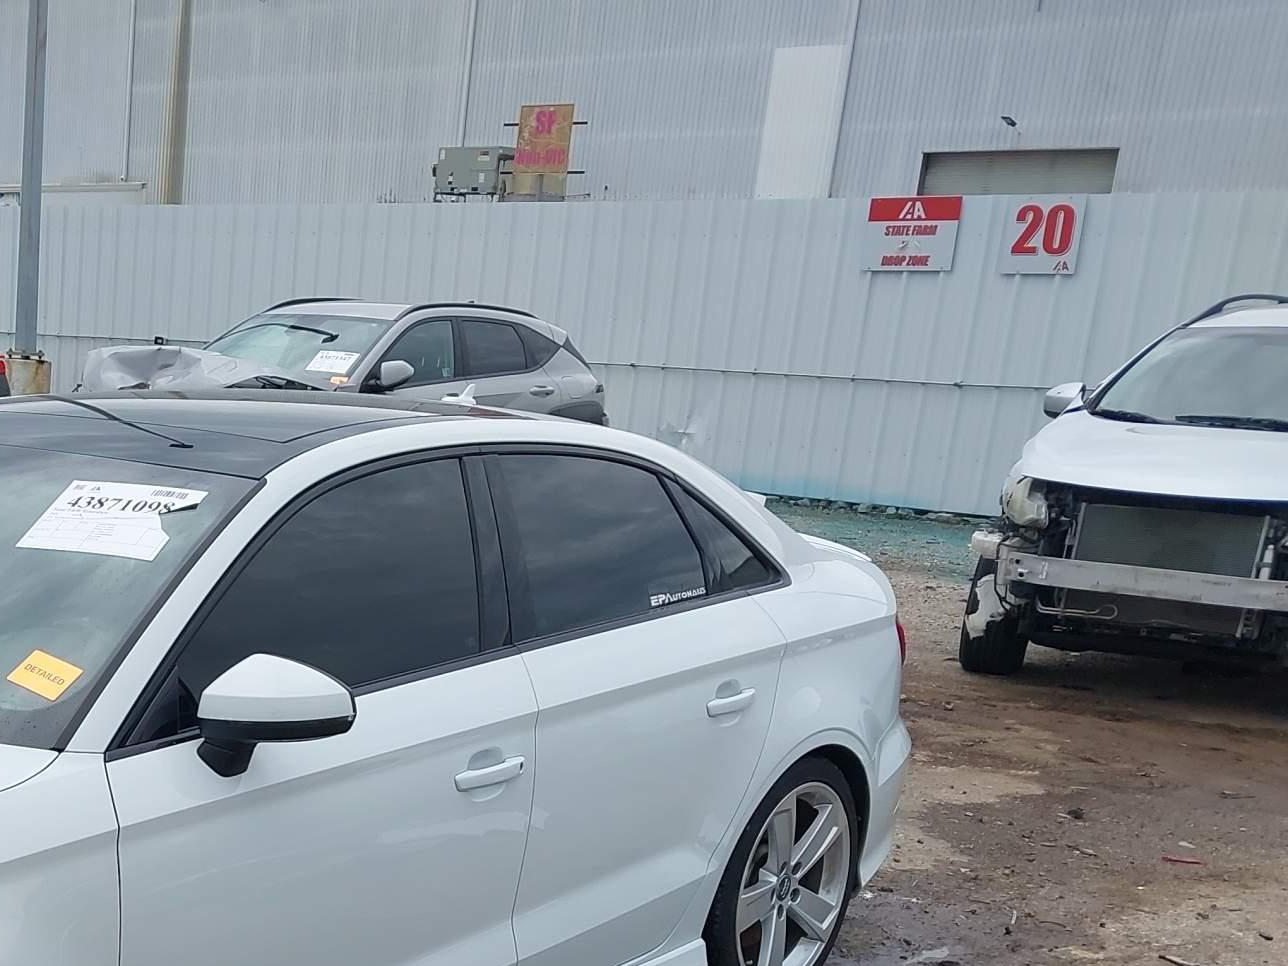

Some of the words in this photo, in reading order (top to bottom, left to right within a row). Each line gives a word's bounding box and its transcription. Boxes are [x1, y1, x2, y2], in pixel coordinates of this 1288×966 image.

[884, 225, 911, 236] STATE
[911, 225, 938, 236] FARM
[1010, 203, 1076, 256] 20
[880, 255, 906, 267] DROP
[906, 255, 931, 267] ZONE
[66, 495, 176, 514] 43871098
[23, 663, 65, 686] DETAILED
